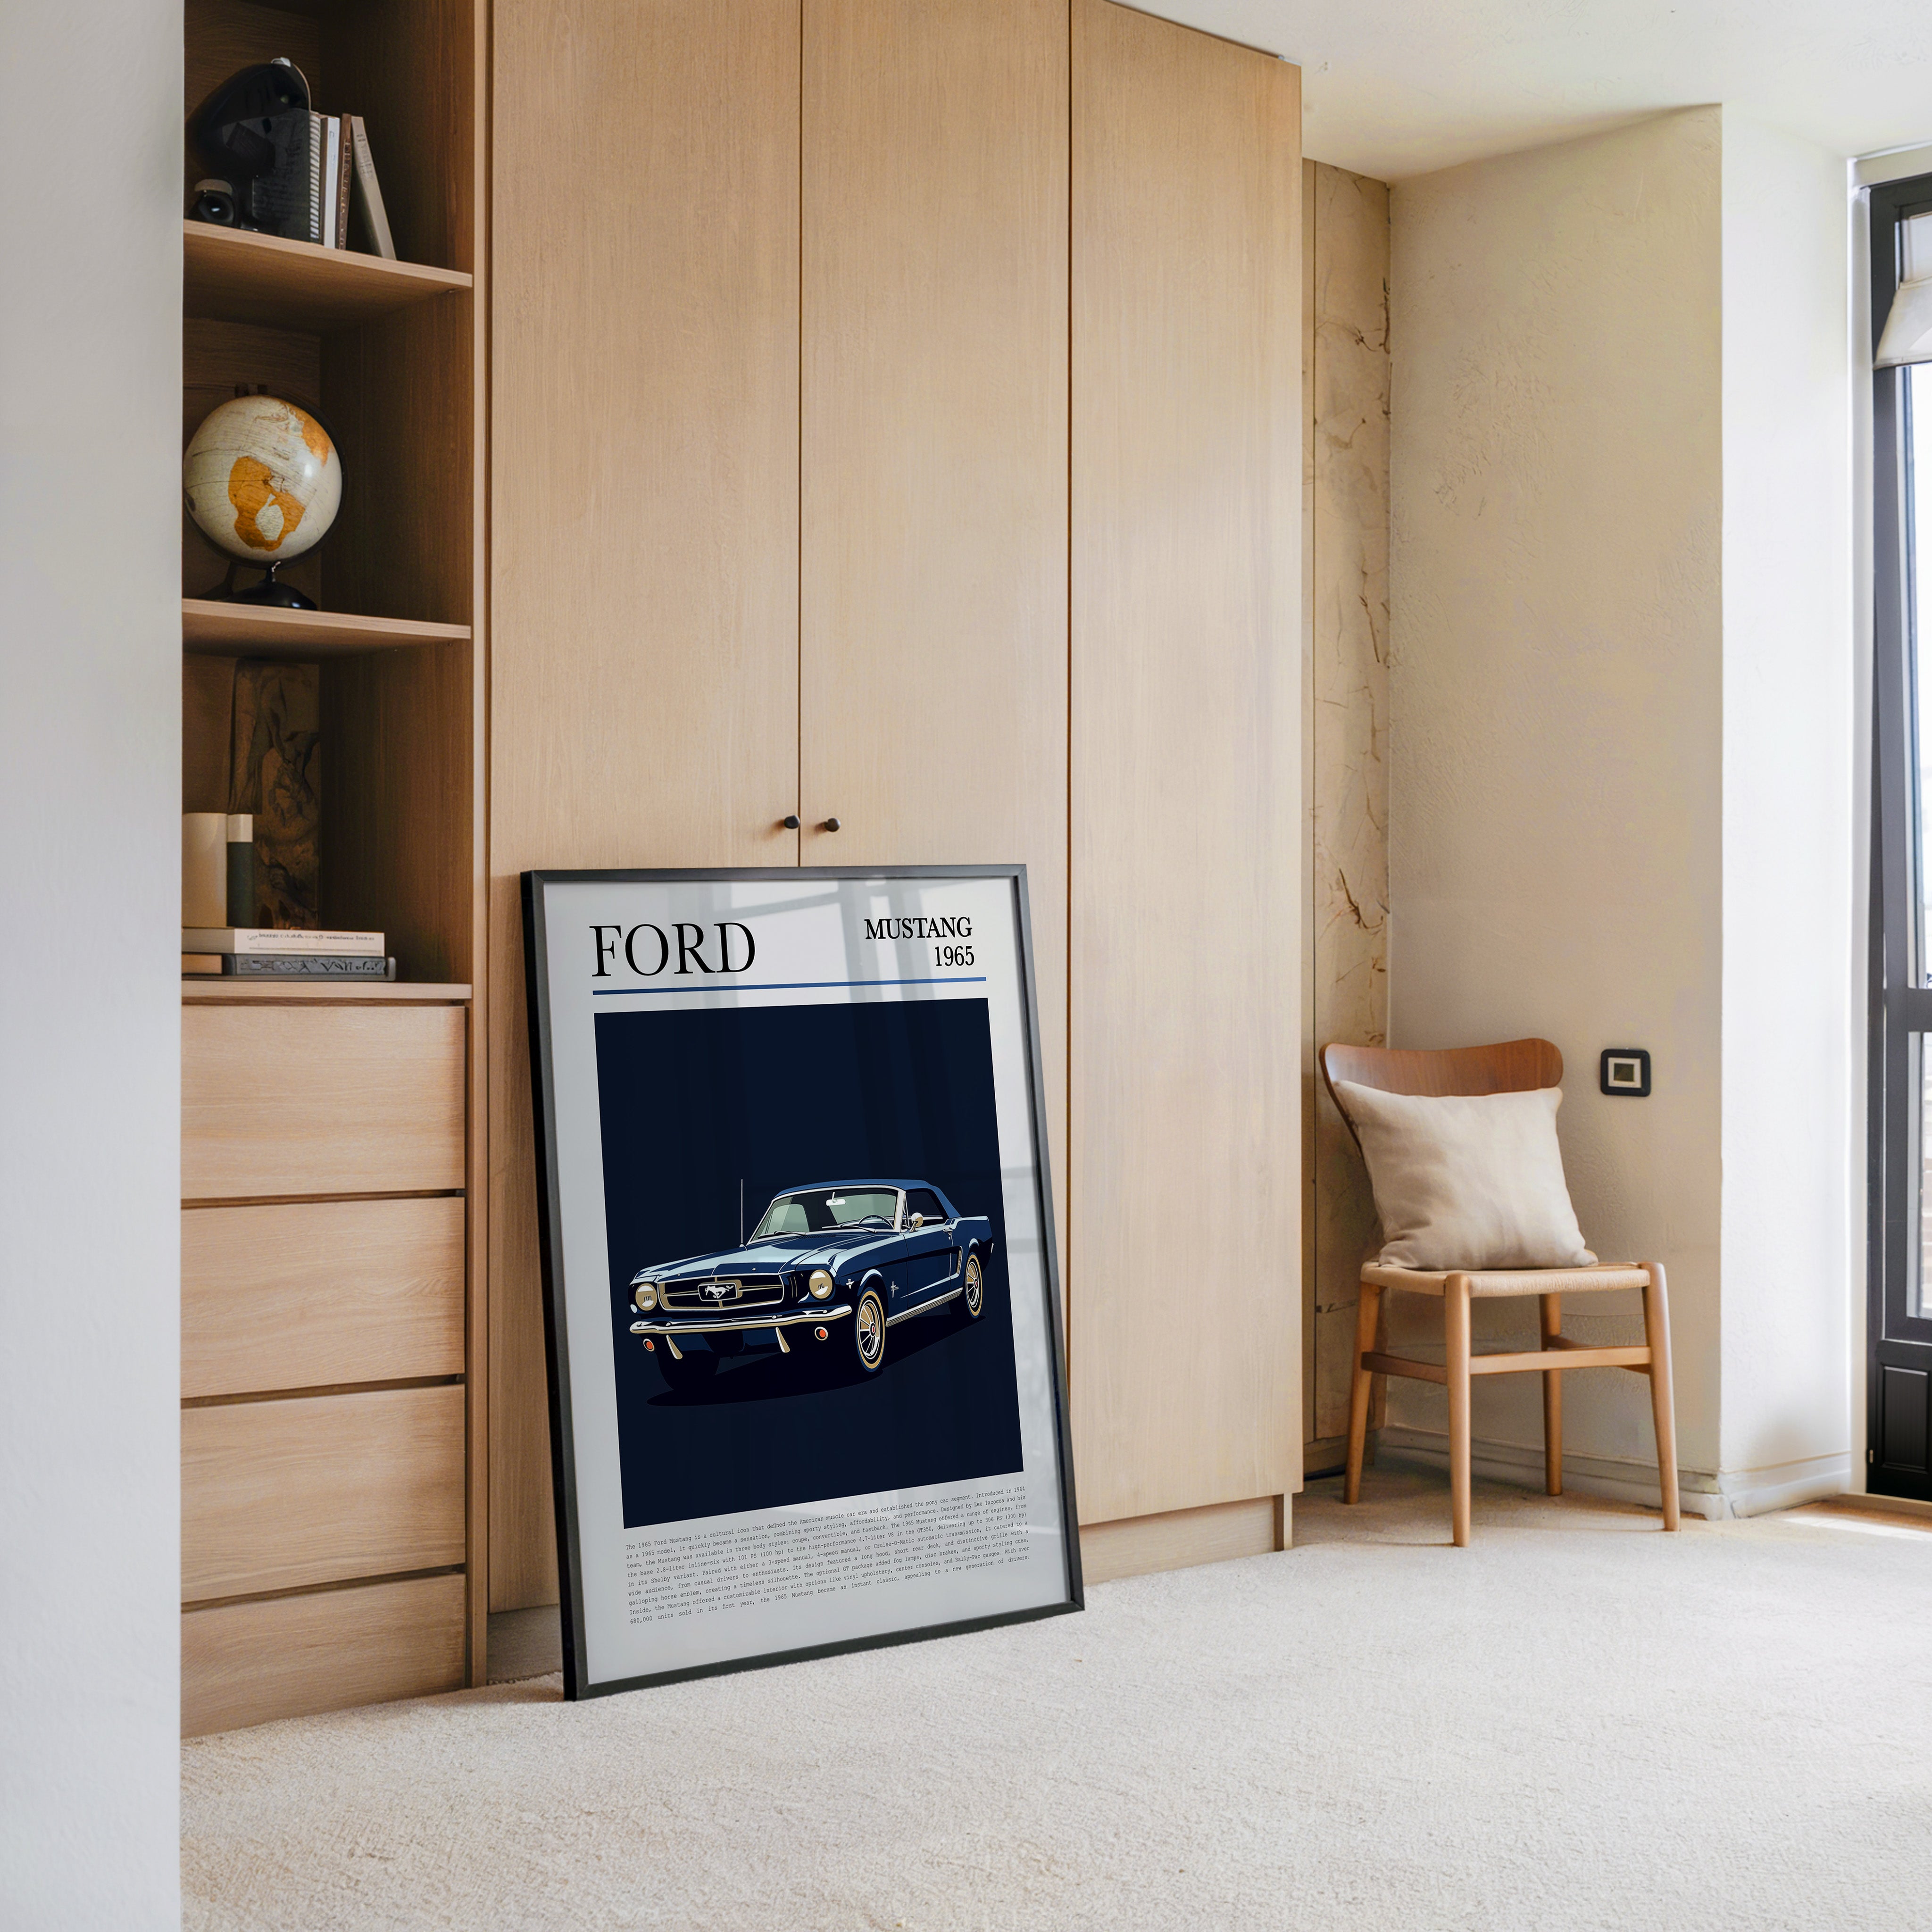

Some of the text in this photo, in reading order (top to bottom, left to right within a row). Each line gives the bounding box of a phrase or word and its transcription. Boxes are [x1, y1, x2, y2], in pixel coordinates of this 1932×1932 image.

[590, 923, 755, 976] FORD
[864, 917, 972, 939] MUSTANG
[935, 946, 974, 966] 1965
[688, 1542, 710, 1551] quickly
[740, 1534, 770, 1542] sensation,
[773, 1529, 801, 1537] combining
[824, 1522, 847, 1530] styling,
[850, 1516, 890, 1526] affordability,
[904, 1509, 938, 1519] performance.
[941, 1504, 964, 1512] Designed
[695, 1549, 724, 1558] available
[813, 1531, 848, 1541] convertible,
[863, 1524, 888, 1532] fastback.
[939, 1513, 959, 1521] offered
[709, 1529, 734, 1538] cultural
[766, 1521, 786, 1529] defined
[881, 1502, 913, 1512] established
[976, 1489, 1004, 1498] Introduced
[702, 1567, 721, 1575] Paired
[768, 1557, 790, 1565] 3-speed
[792, 1554, 813, 1562] manual,
[817, 1549, 838, 1557] 4-speed
[874, 1538, 915, 1549] Cruise-O-Matic
[917, 1533, 943, 1542] automatic
[946, 1528, 982, 1538] transmission,
[994, 1522, 1014, 1530] catered
[628, 1597, 658, 1607] galloping
[705, 1585, 731, 1593] creating
[740, 1580, 765, 1588] timeless
[767, 1574, 800, 1583] silhouette.
[816, 1567, 840, 1577] optional
[852, 1563, 873, 1571] package
[630, 1607, 651, 1615] Inside,
[692, 1596, 715, 1605] offered
[723, 1589, 761, 1600] customizable
[764, 1585, 788, 1593] interior
[805, 1579, 826, 1587] options
[861, 1569, 892, 1578] upholstery,
[916, 1561, 941, 1569] consoles,
[955, 1554, 981, 1562] Rally-Pac
[630, 1615, 652, 1624] 680,000
[876, 1576, 899, 1584] classic,
[904, 1571, 930, 1580] appealing
[966, 1561, 994, 1571] generation
